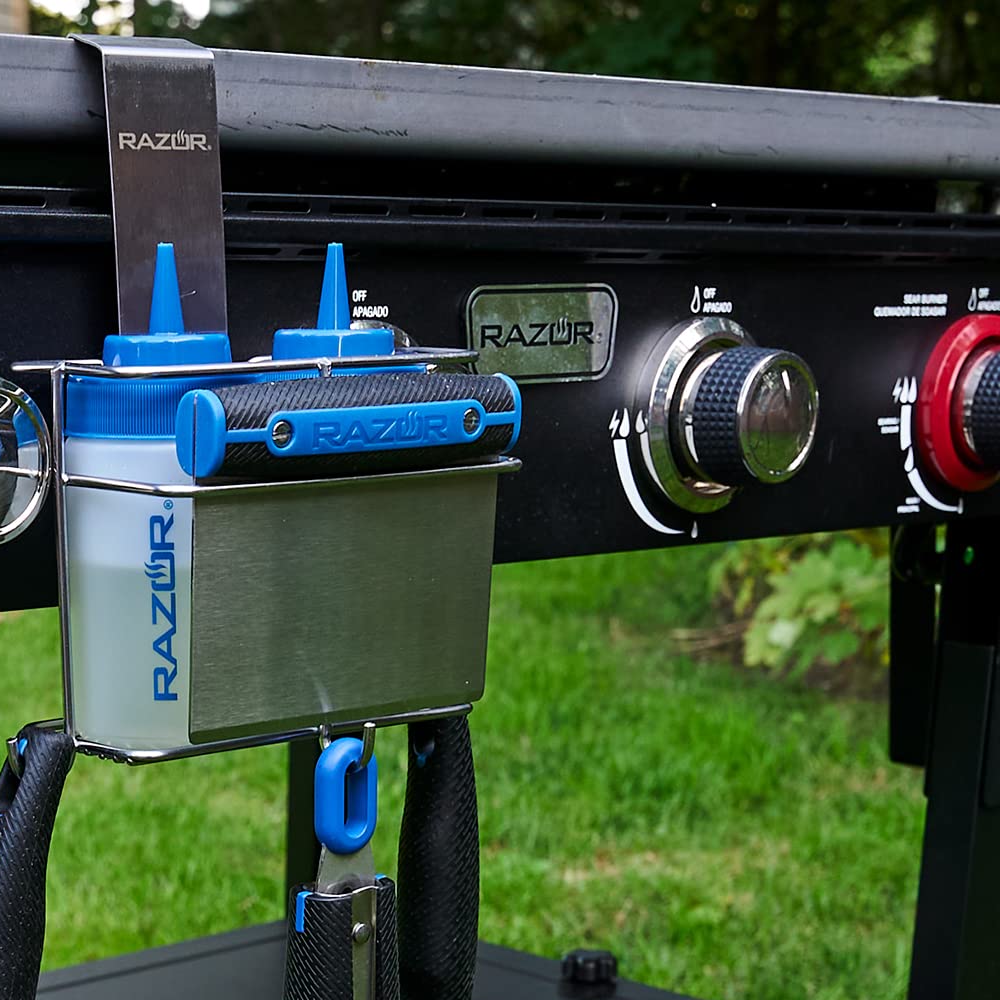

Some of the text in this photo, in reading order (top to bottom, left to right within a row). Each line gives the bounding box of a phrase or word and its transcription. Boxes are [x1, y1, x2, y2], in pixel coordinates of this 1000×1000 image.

[352, 290, 367, 302] OFF
[353, 306, 388, 317] APAGADO
[480, 317, 595, 348] RAZOR
[312, 412, 448, 450] RAZOR
